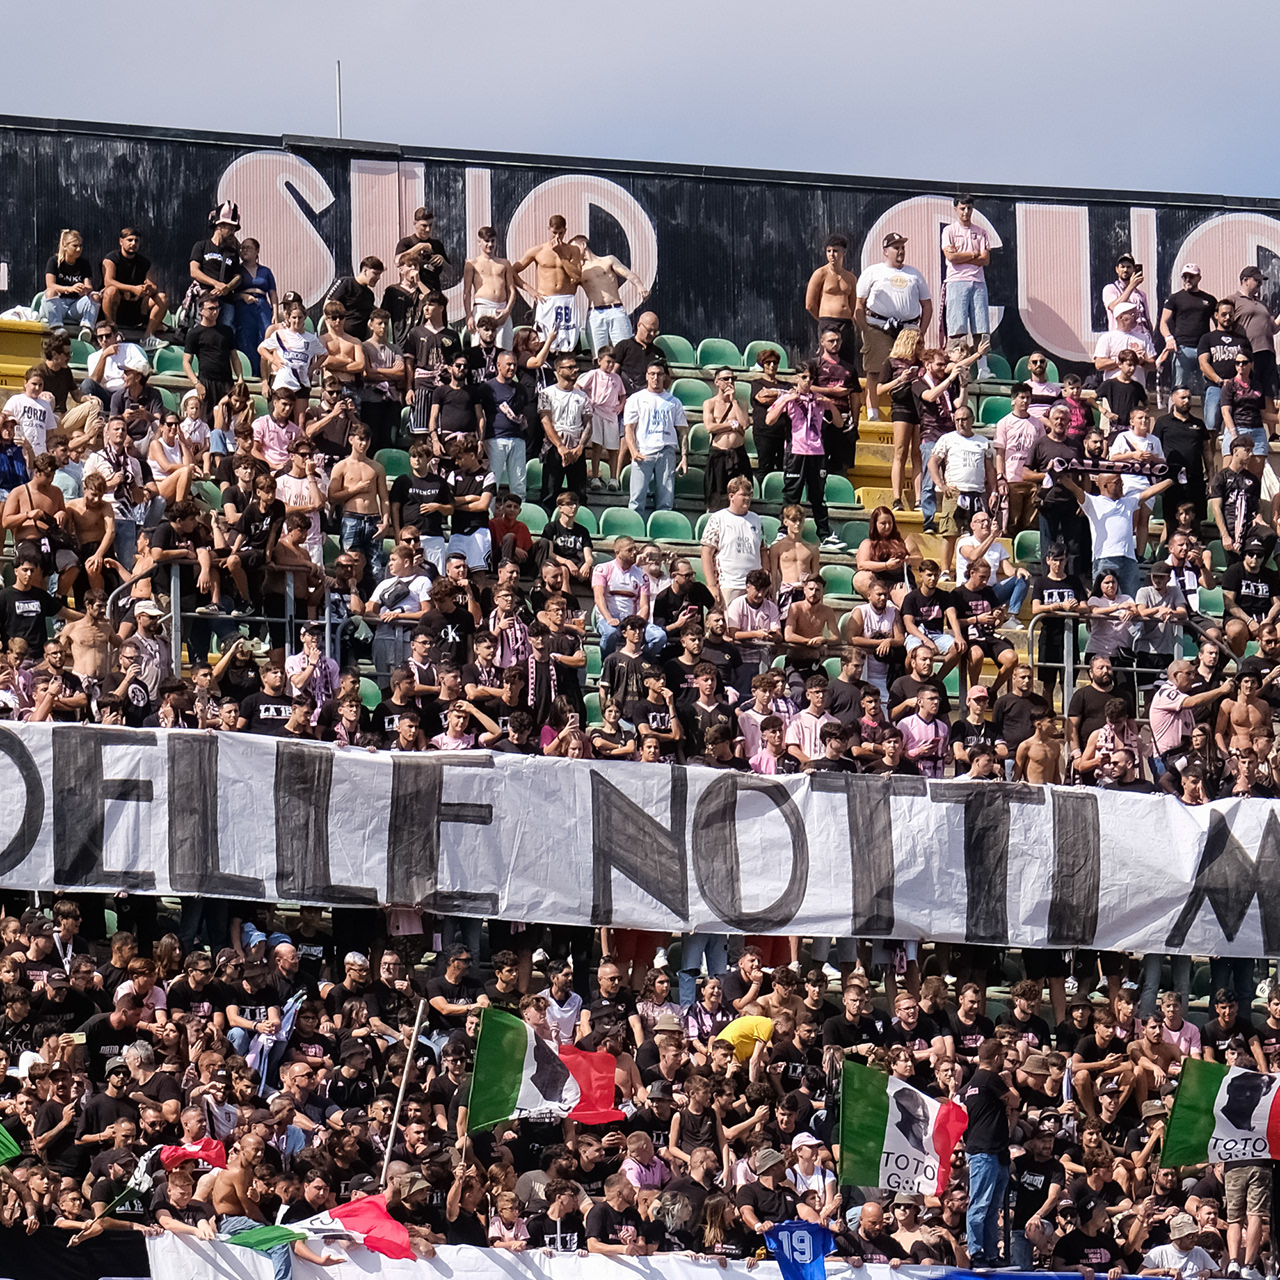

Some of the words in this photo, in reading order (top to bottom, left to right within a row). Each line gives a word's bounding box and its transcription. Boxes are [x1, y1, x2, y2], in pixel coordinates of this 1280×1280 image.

[216, 150, 659, 323] SUO
[408, 487, 440, 495] GIVENCHY
[590, 762, 1101, 947] NOTTI
[777, 1230, 813, 1264] 19
